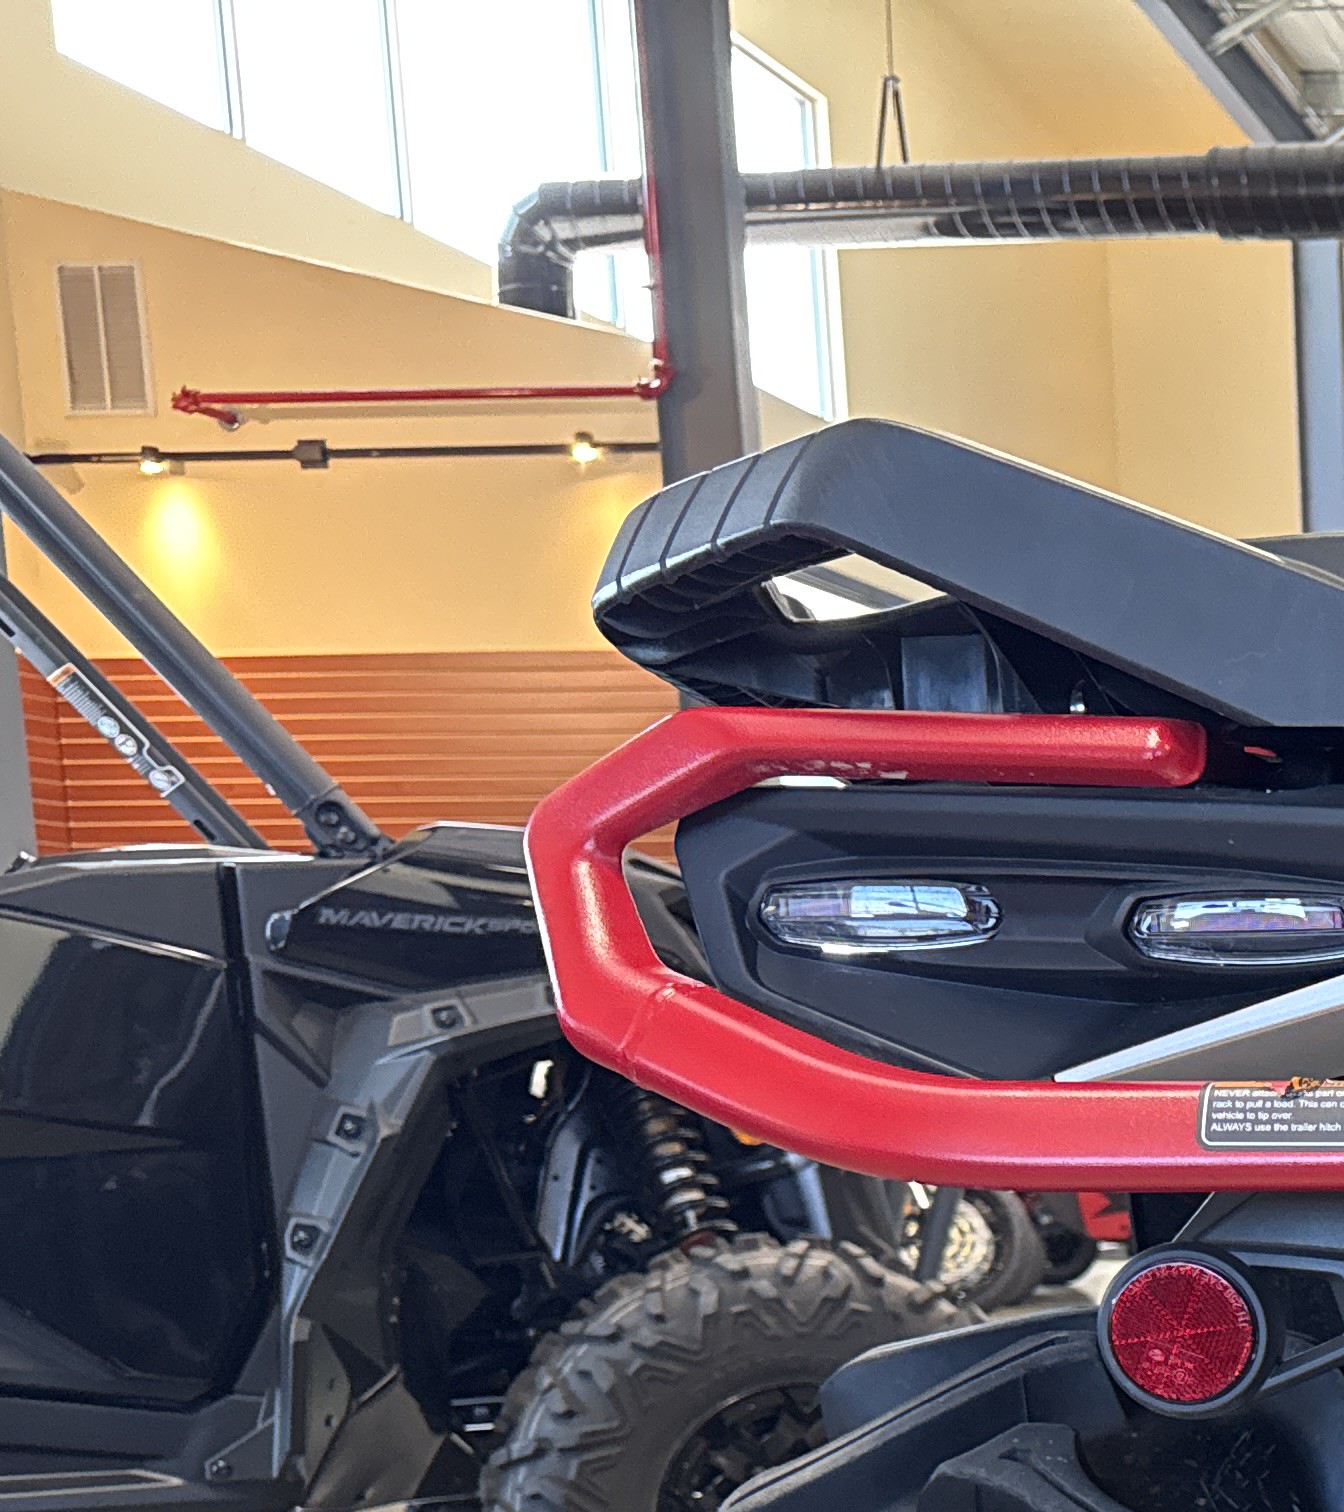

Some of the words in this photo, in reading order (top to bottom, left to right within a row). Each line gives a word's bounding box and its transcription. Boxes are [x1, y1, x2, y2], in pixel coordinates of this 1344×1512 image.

[317, 906, 485, 934] MAVERICK
[486, 917, 537, 934] SPO
[1213, 1089, 1250, 1097] NEVER
[1212, 1100, 1233, 1108] rack
[1235, 1100, 1245, 1108] to
[1246, 1100, 1263, 1110] pull
[1298, 1100, 1318, 1108] This
[1211, 1111, 1245, 1120] vehicle
[1246, 1111, 1256, 1120] to
[1210, 1122, 1252, 1132] ALWAYS
[1254, 1124, 1272, 1132] use
[1273, 1122, 1289, 1132] the
[1290, 1122, 1317, 1132] trailer
[1319, 1122, 1342, 1132] hitch
